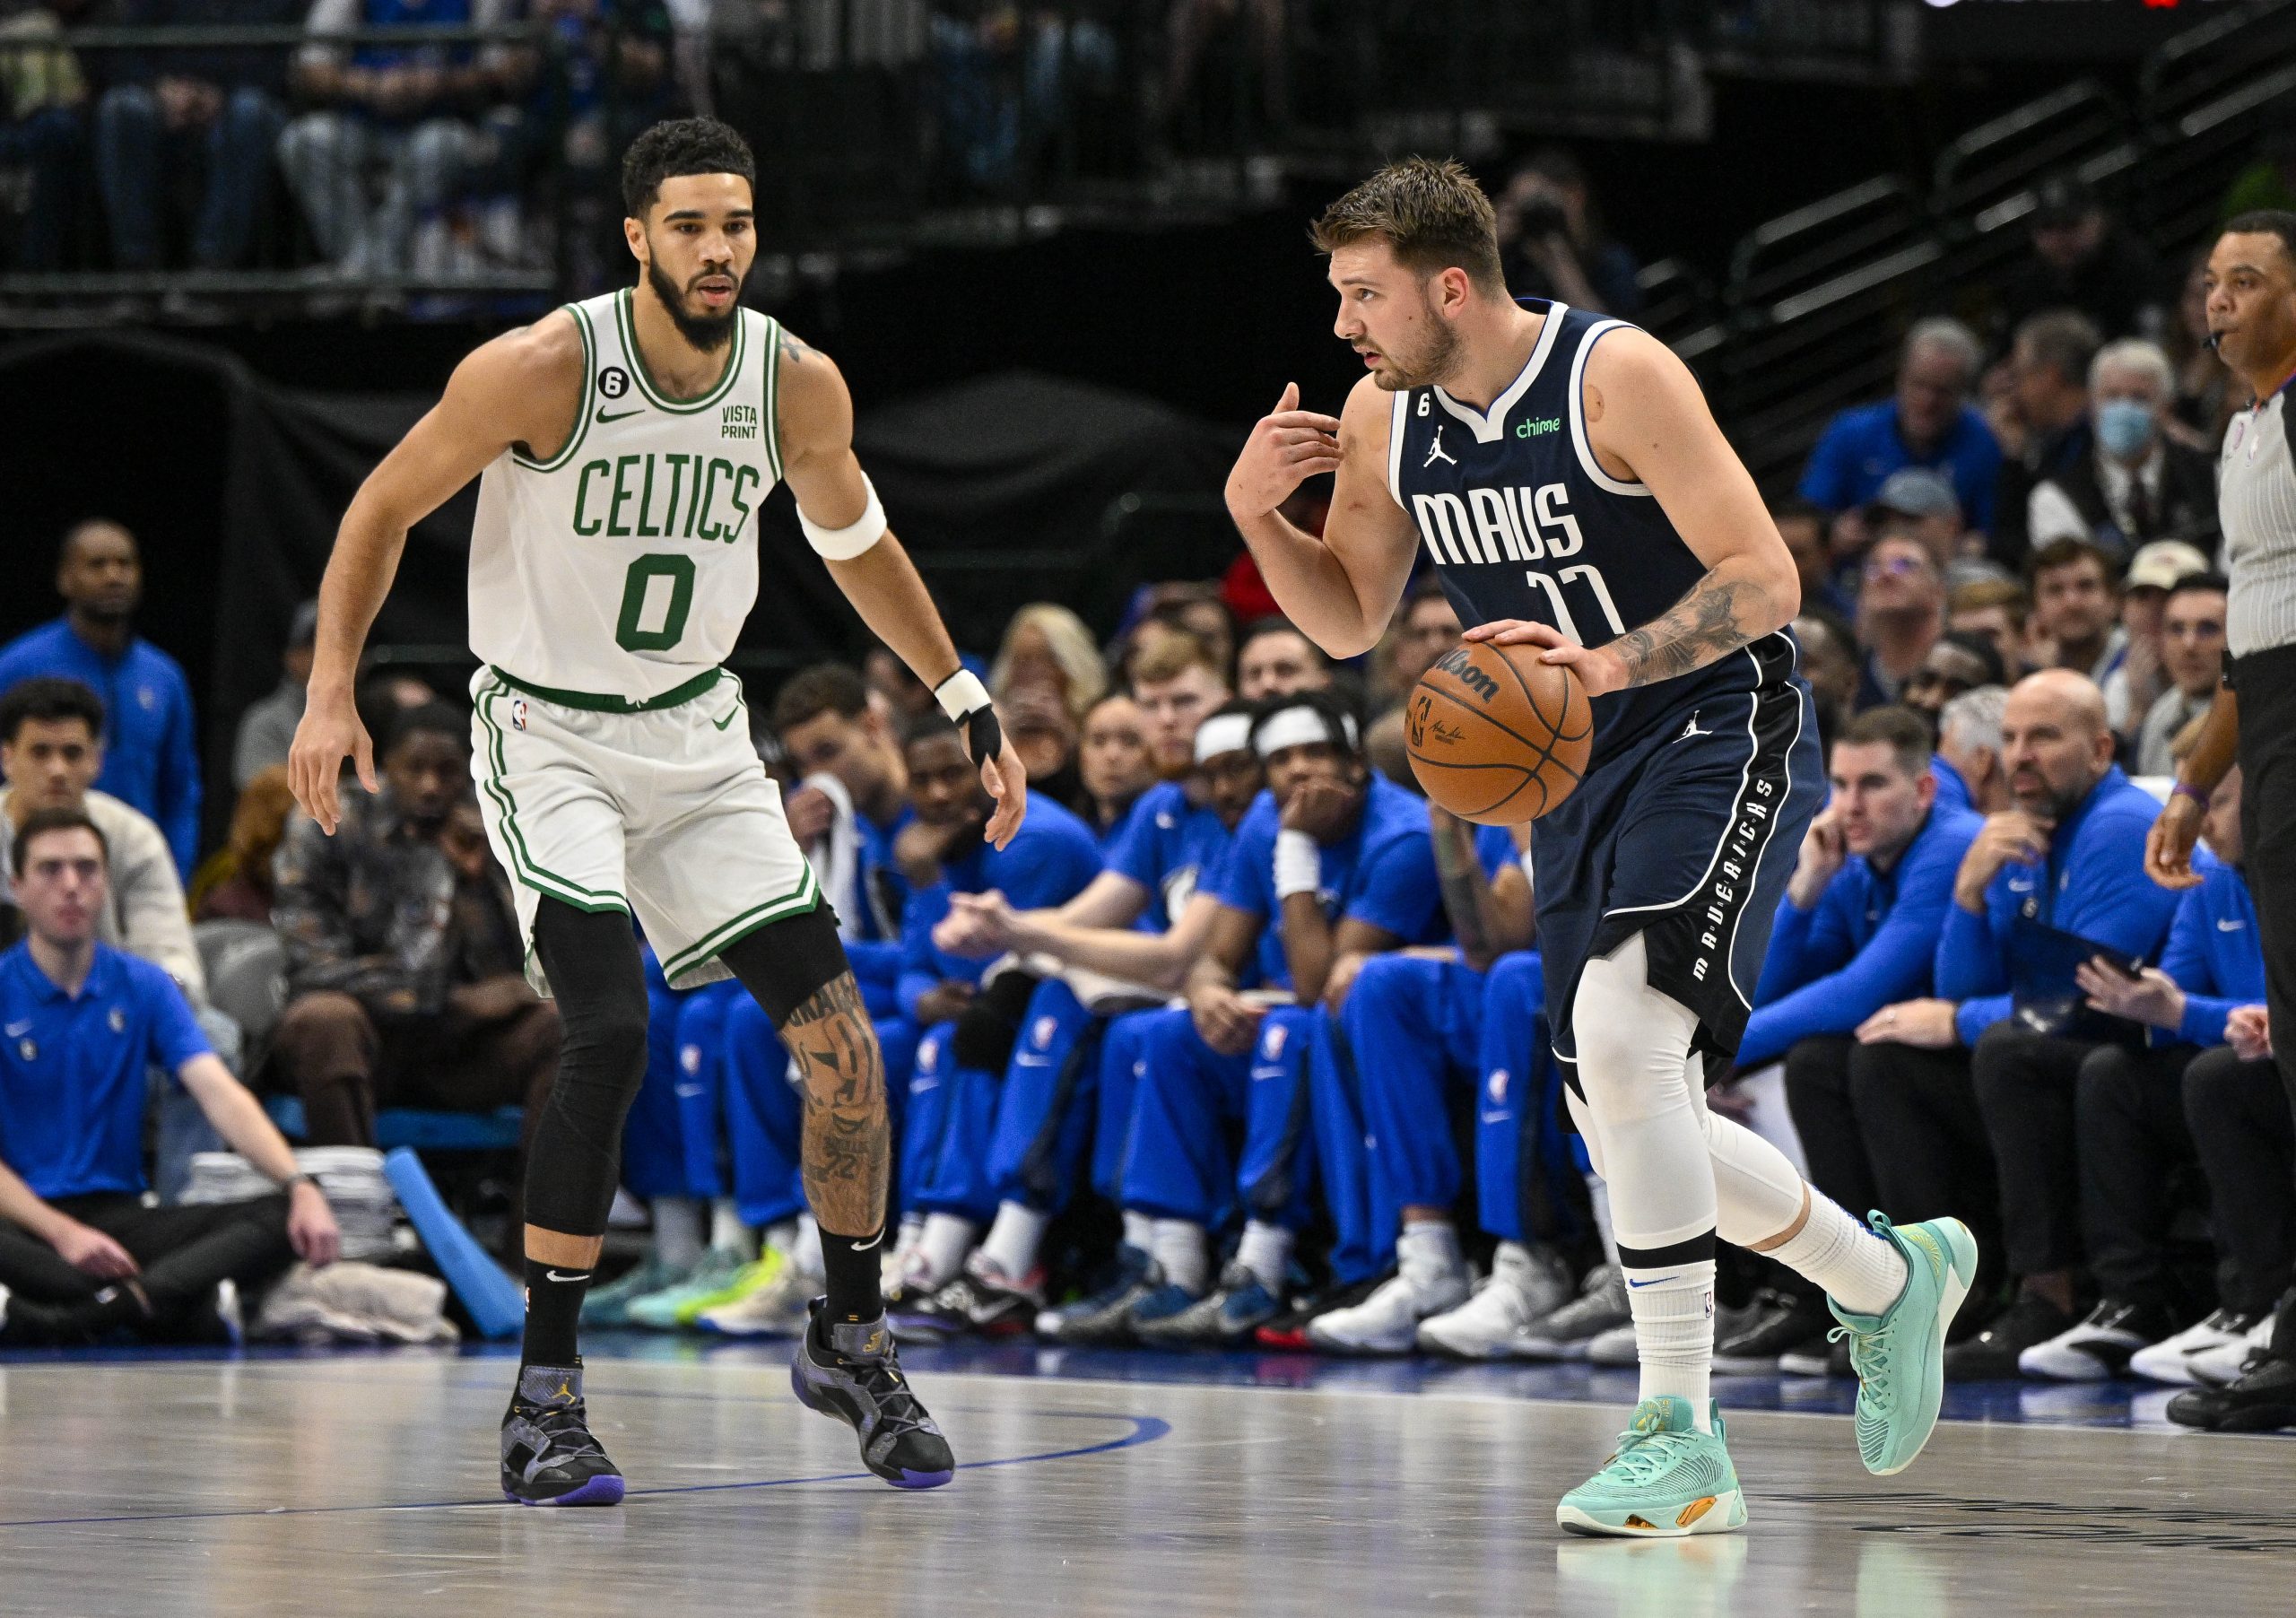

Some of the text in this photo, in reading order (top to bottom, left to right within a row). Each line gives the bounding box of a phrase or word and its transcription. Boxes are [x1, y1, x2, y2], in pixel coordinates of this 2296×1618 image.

[604, 370, 622, 396] 6
[1417, 392, 1431, 417] 6
[721, 425, 758, 439] PRINT
[722, 404, 758, 425] VISTA
[1516, 416, 1561, 439] chime
[572, 453, 761, 544] CELTICS
[1412, 483, 1584, 566] MAVS
[615, 553, 696, 653] 0
[1526, 564, 1626, 646] 77
[1692, 779, 1773, 982] MAVERICKS
